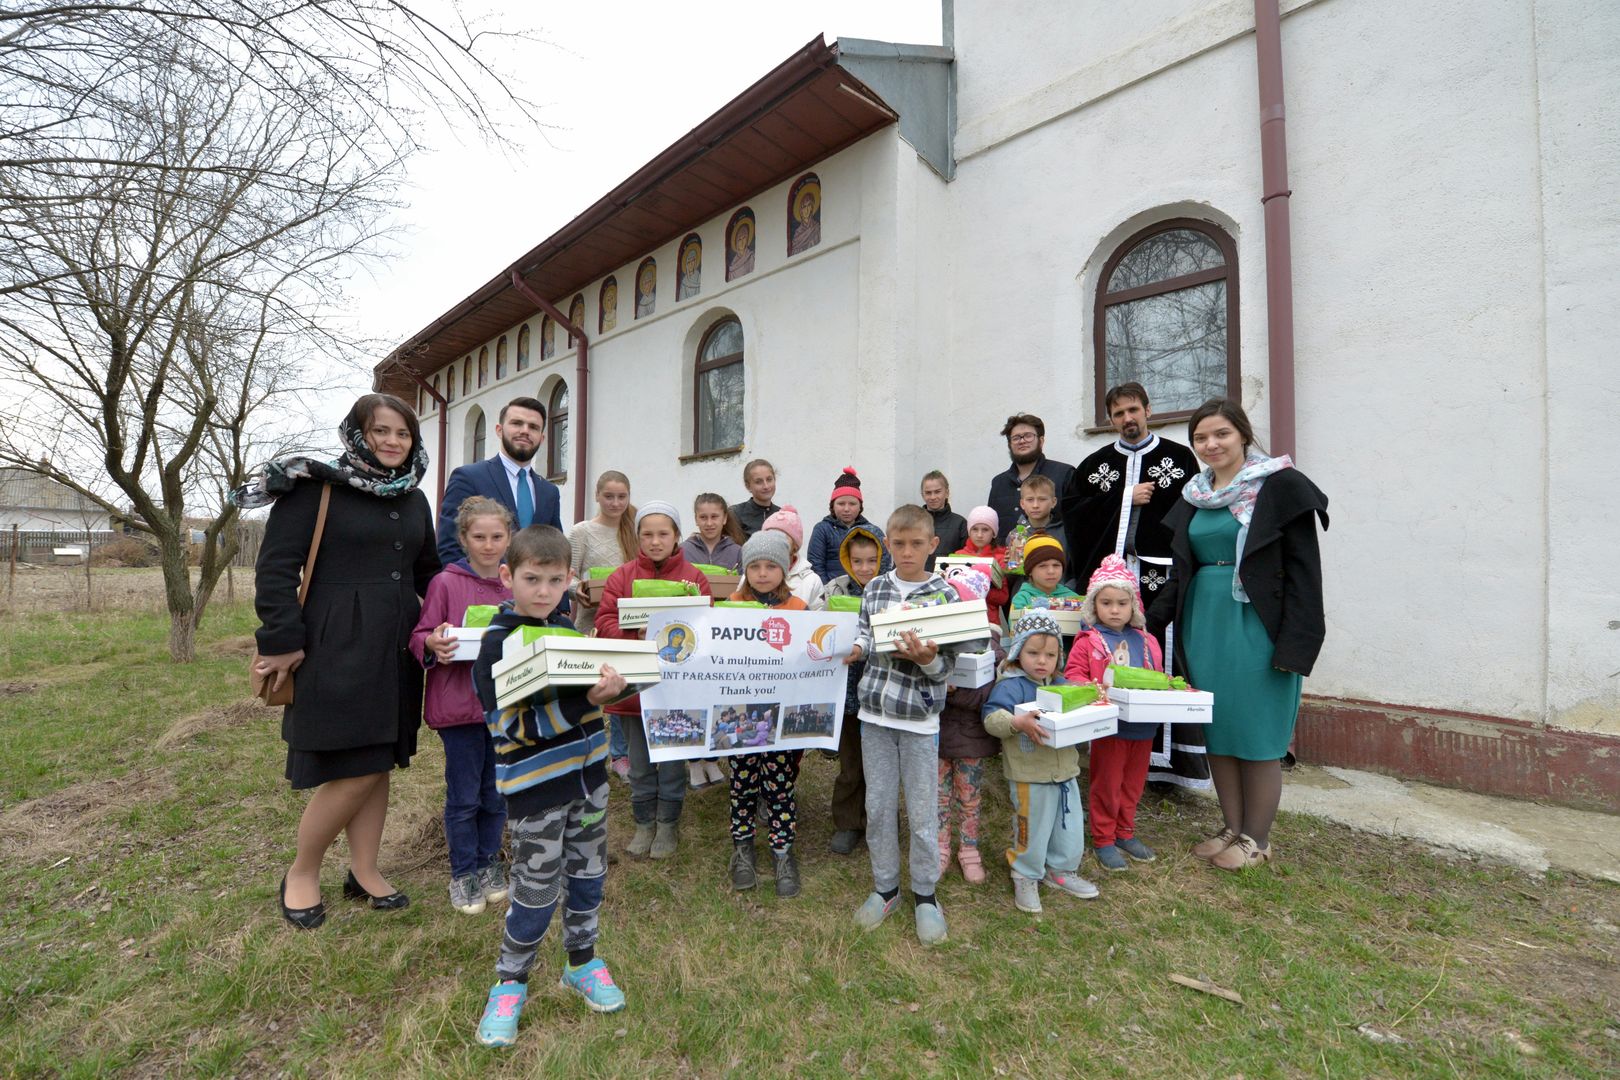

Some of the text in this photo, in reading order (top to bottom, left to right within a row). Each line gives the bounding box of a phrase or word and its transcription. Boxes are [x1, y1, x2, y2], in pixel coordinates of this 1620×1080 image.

[557, 659, 595, 670] Marelbo
[663, 667, 837, 681] INT PARASKEVA ORTHODOX CHARITY
[719, 685, 776, 697] Thank you!
